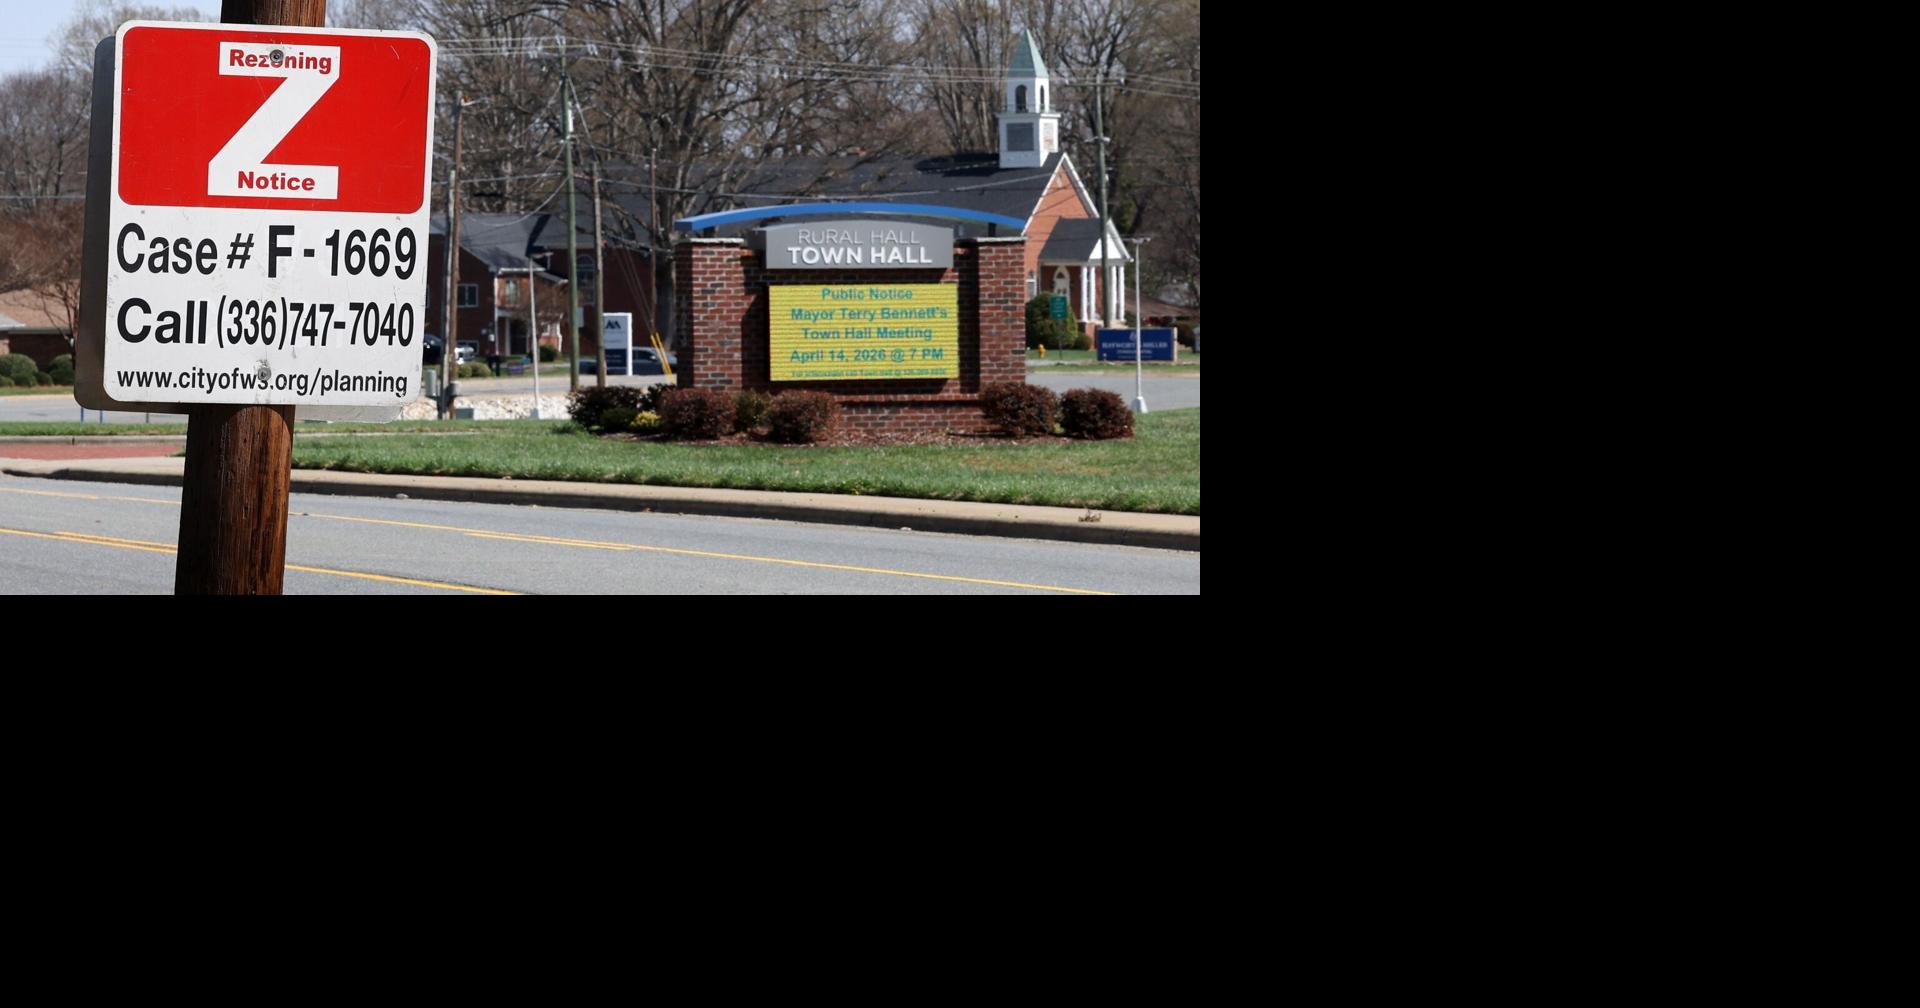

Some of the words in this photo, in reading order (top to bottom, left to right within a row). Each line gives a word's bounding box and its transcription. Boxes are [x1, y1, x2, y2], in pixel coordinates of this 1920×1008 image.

[237, 171, 316, 191] Notice
[798, 229, 864, 244] RURAL
[870, 229, 920, 244] HALL
[117, 222, 218, 275] Case
[226, 232, 255, 270] #
[787, 246, 862, 264] TOWN
[870, 246, 933, 264] HALL
[822, 288, 864, 300] Public
[869, 288, 913, 300] Notice
[117, 297, 207, 344] Call
[791, 308, 836, 323] Mayor
[840, 307, 877, 322] Terry
[880, 306, 948, 320] Bennett's
[802, 327, 840, 340] Town
[845, 327, 872, 339] Hall
[877, 326, 933, 341] Meeting
[790, 349, 824, 364] April
[854, 348, 887, 361] 2026
[910, 348, 917, 361] 7
[921, 347, 944, 361] PM
[117, 366, 408, 398] www.cityofws.org/planning
